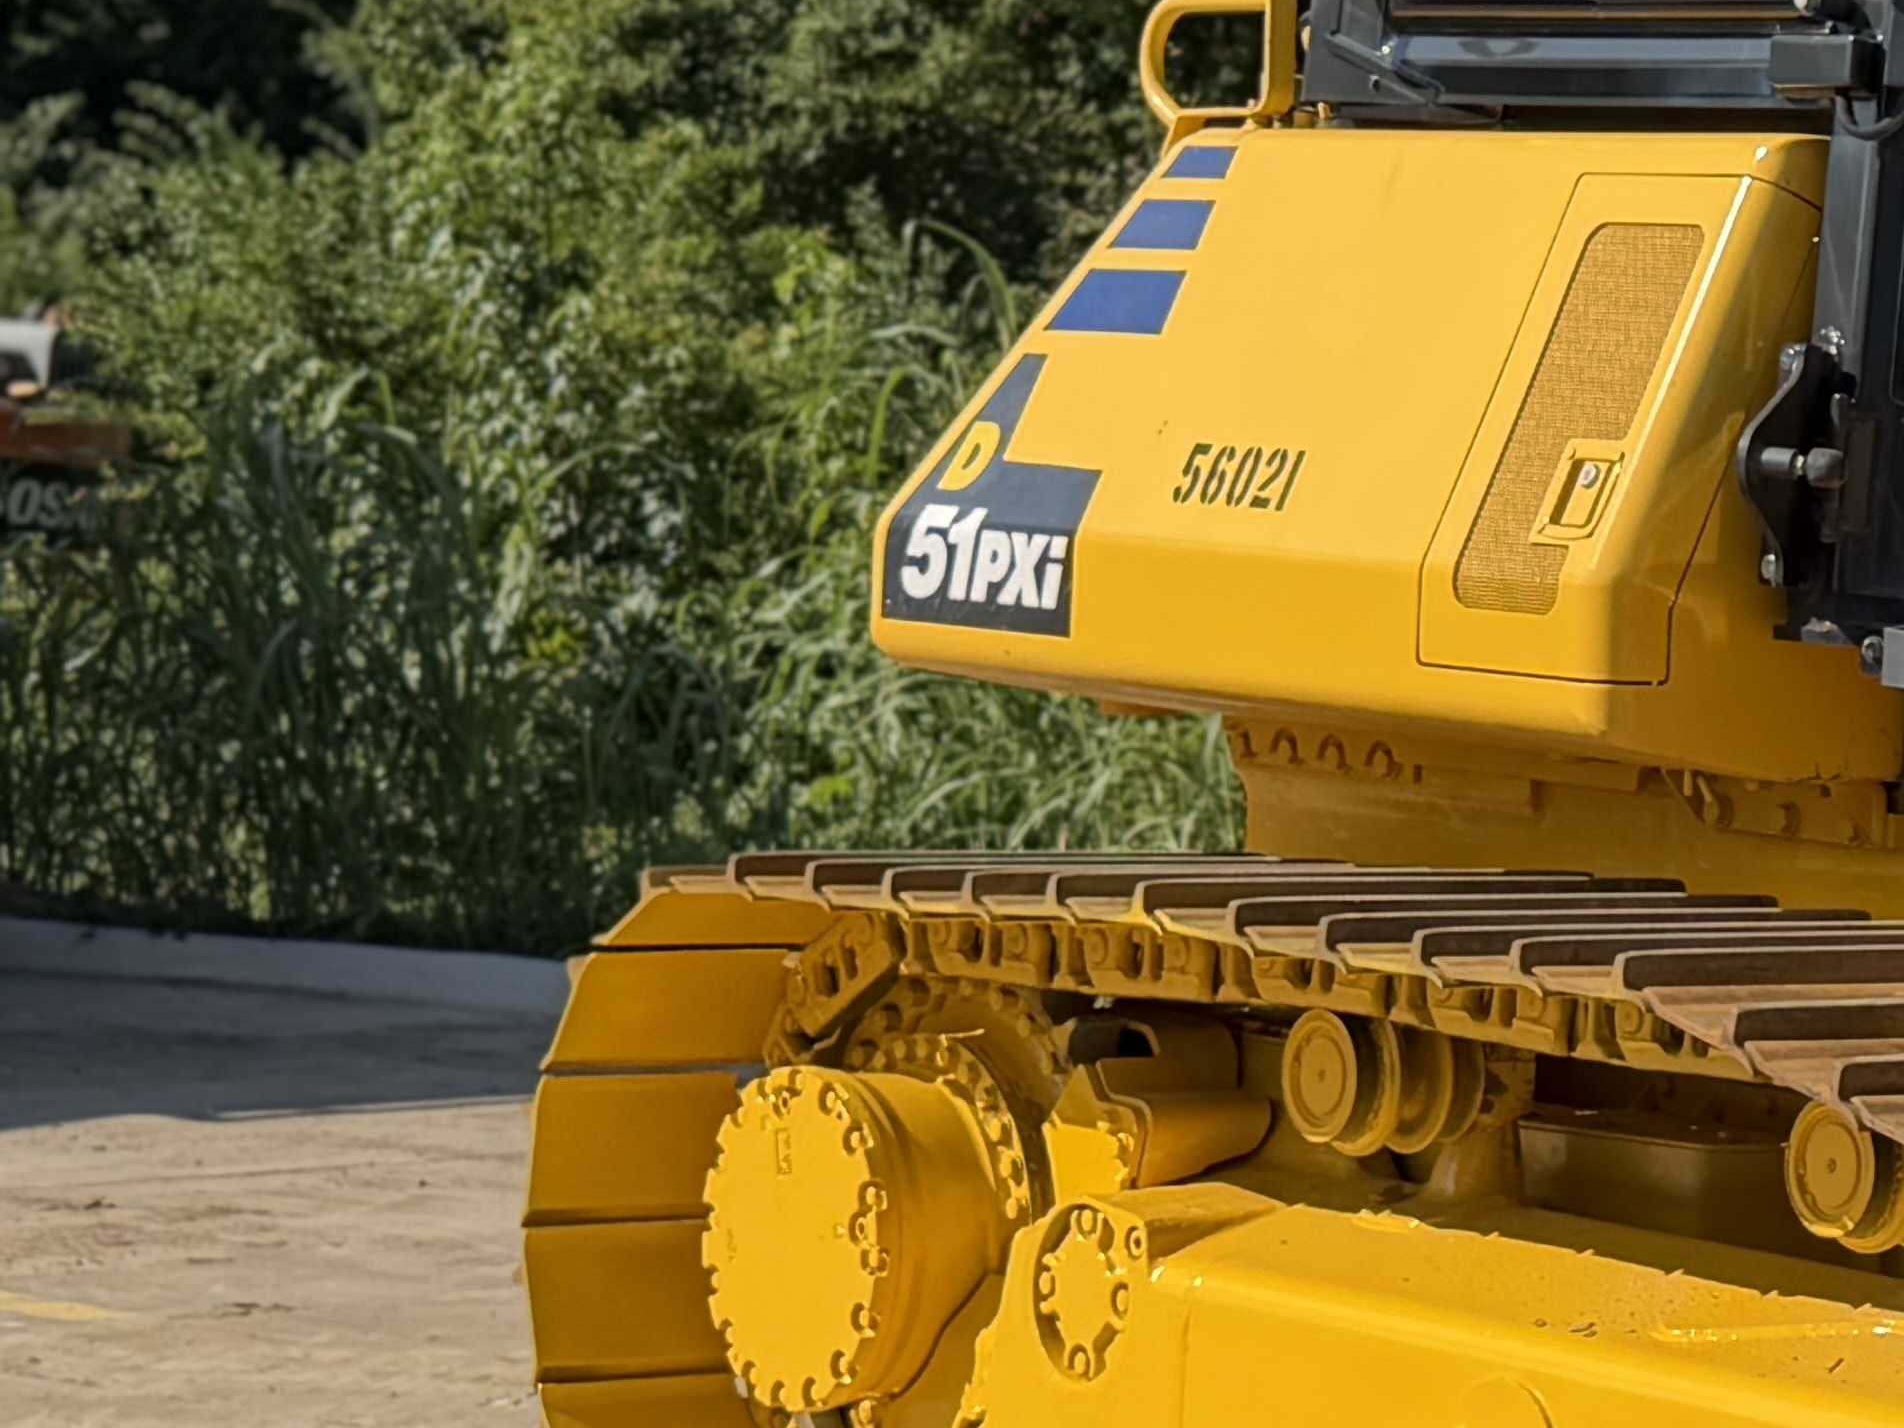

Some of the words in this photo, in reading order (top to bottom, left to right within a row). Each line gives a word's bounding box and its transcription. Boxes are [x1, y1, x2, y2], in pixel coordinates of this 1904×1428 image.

[936, 421, 1001, 491] D
[1172, 442, 1306, 512] 56021
[901, 503, 1069, 610] 51PXi
